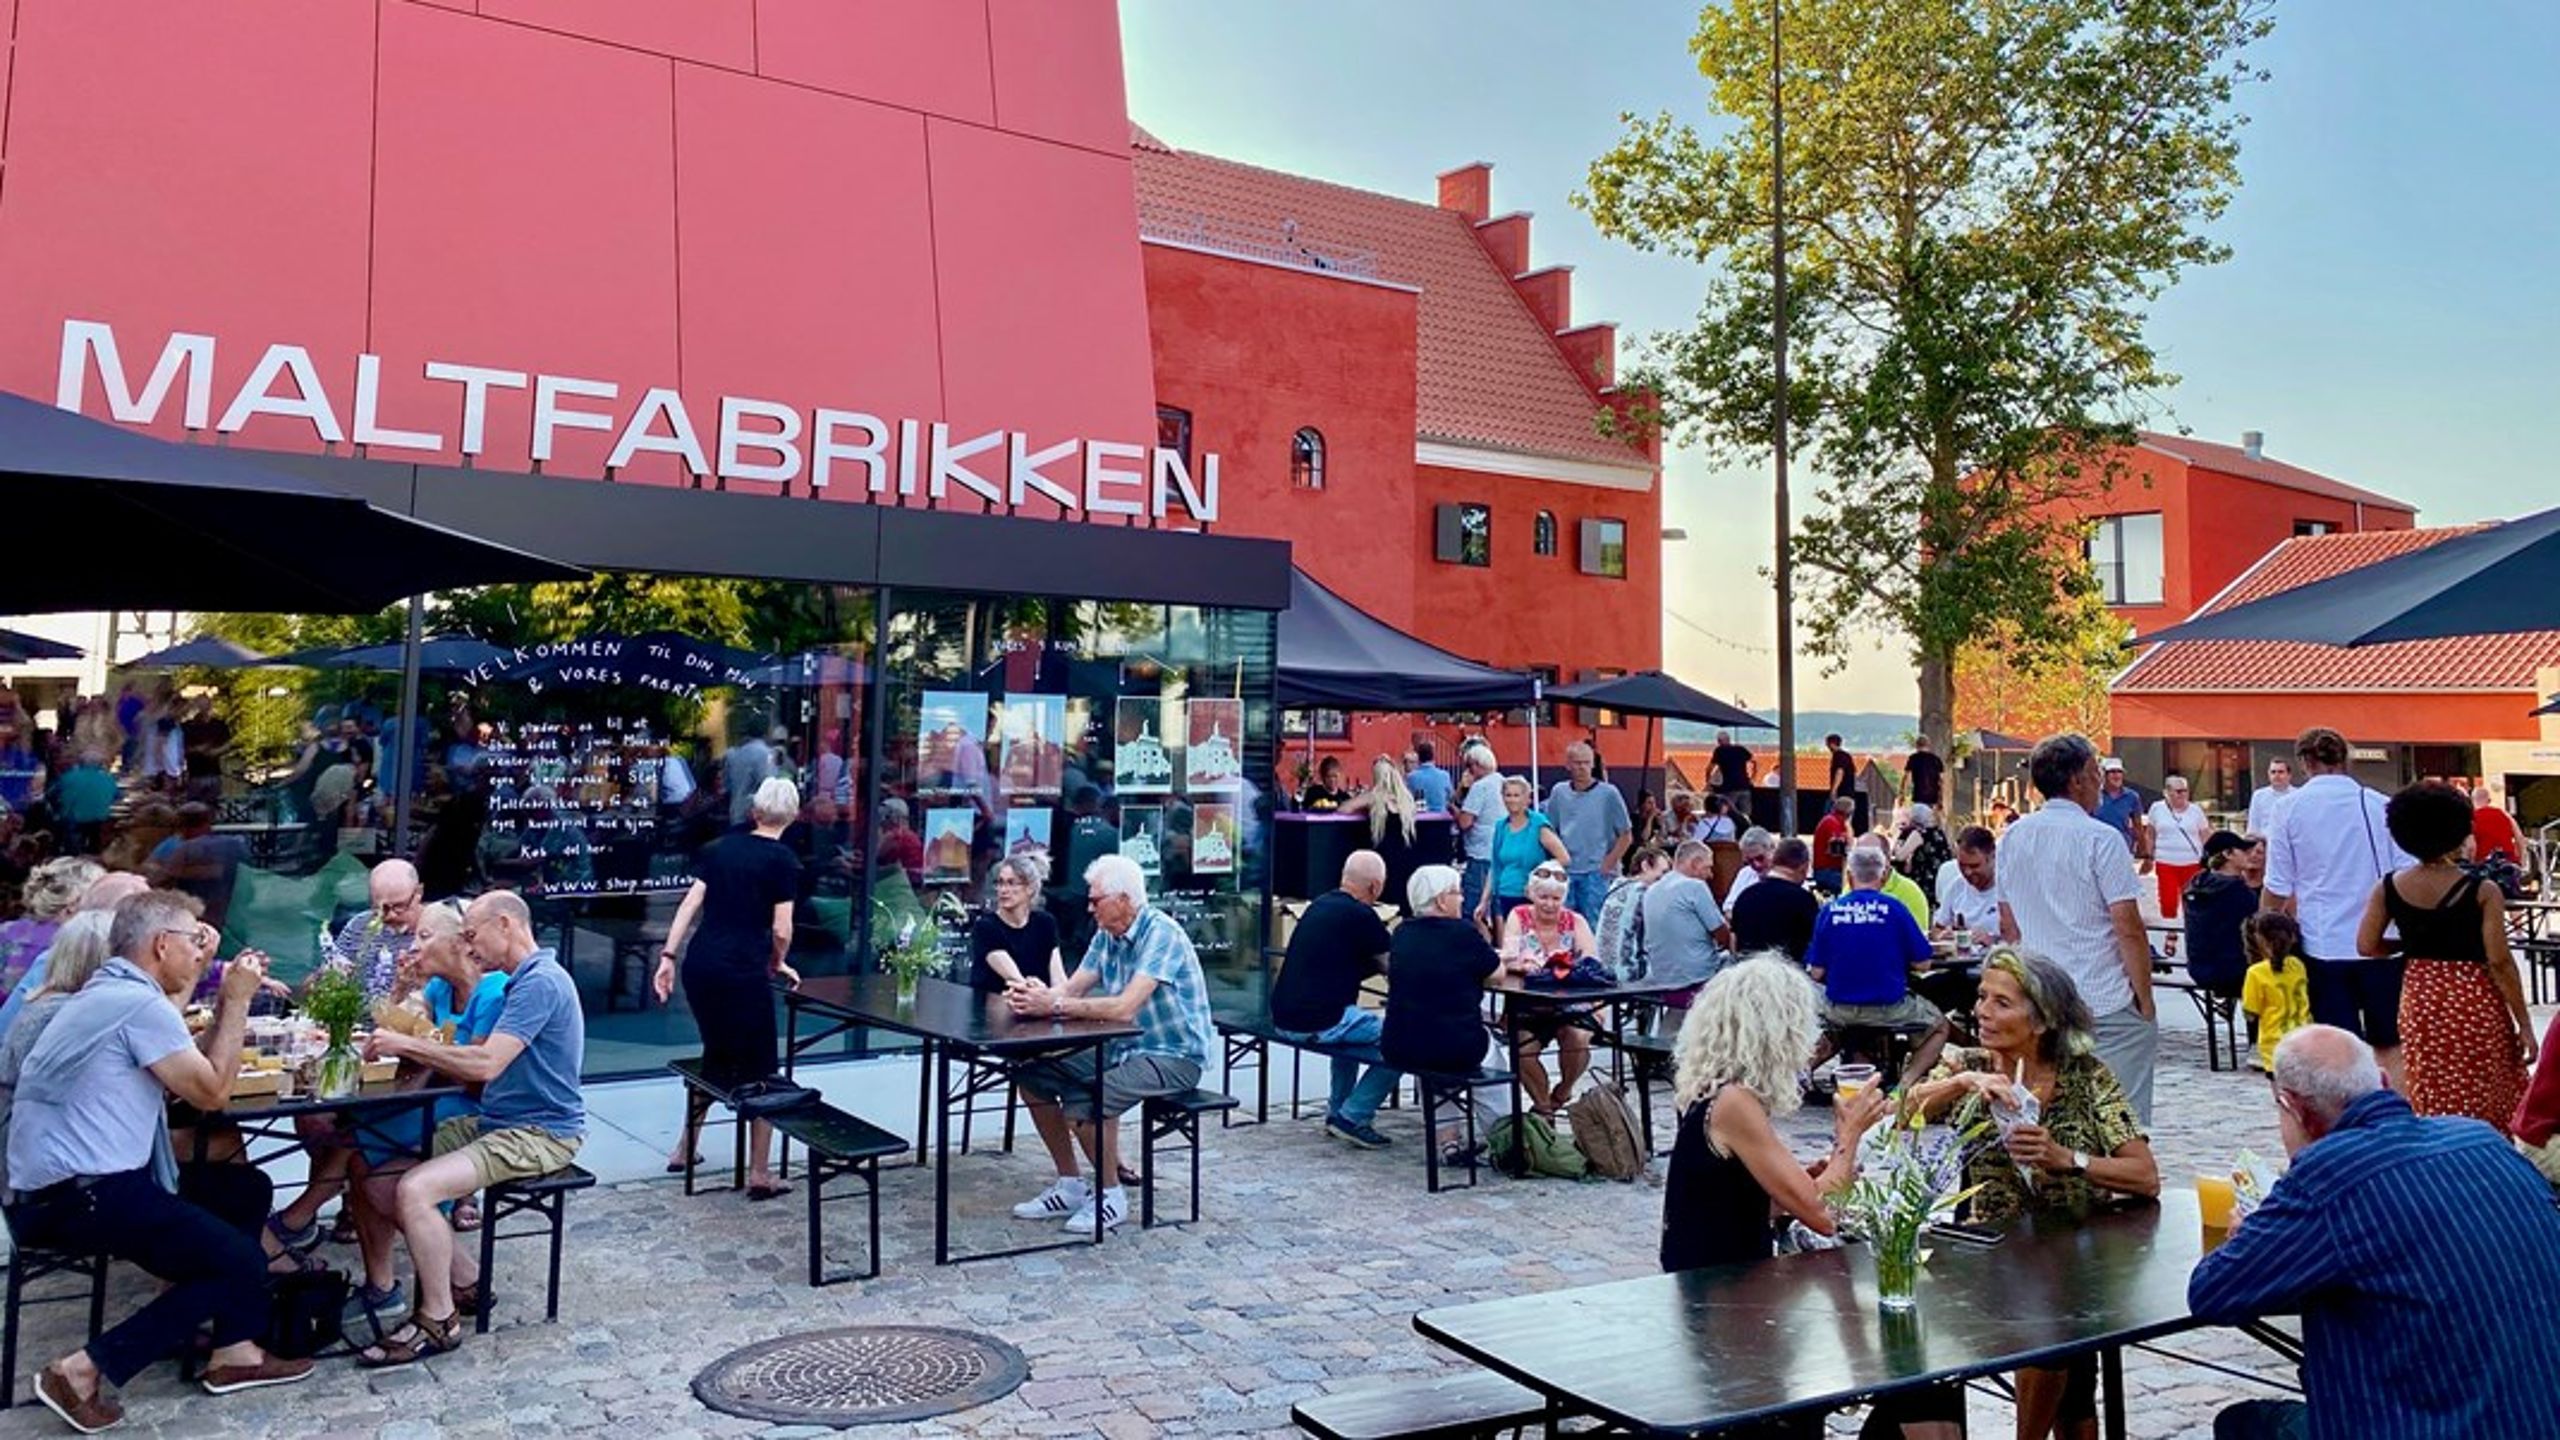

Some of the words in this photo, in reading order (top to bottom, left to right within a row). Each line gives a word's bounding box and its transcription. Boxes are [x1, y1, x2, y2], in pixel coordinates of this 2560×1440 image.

[56, 319, 1219, 523] MALTFABRIKKEN
[463, 641, 622, 688] VELKOMMEN
[527, 676, 545, 695] &
[559, 666, 622, 685] VORES
[638, 673, 705, 706] FABRIK
